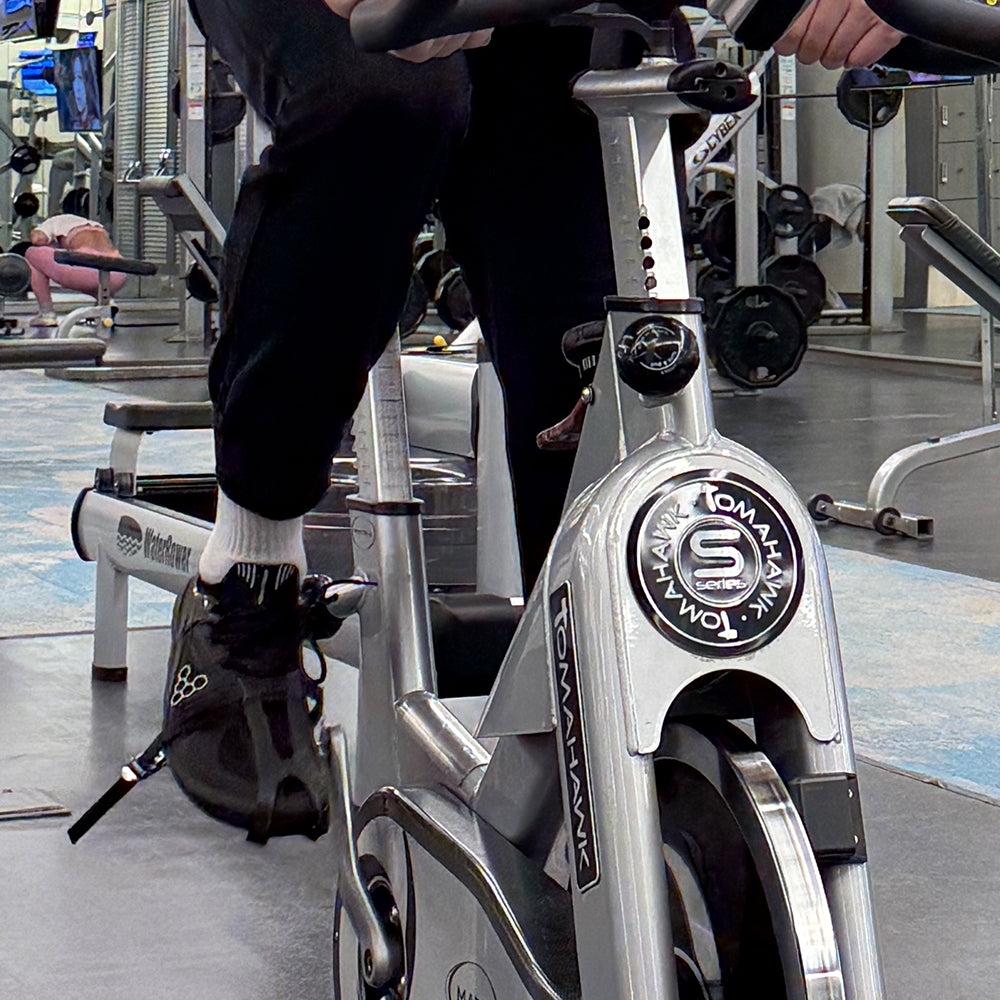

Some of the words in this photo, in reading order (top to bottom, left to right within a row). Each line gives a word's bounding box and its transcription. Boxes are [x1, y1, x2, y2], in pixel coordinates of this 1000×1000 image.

[652, 504, 738, 640] TOMAHAWK
[689, 528, 745, 578] S
[695, 578, 748, 591] series
[702, 482, 783, 620] TOMAHAWK
[554, 597, 590, 871] TOMAHAWK
